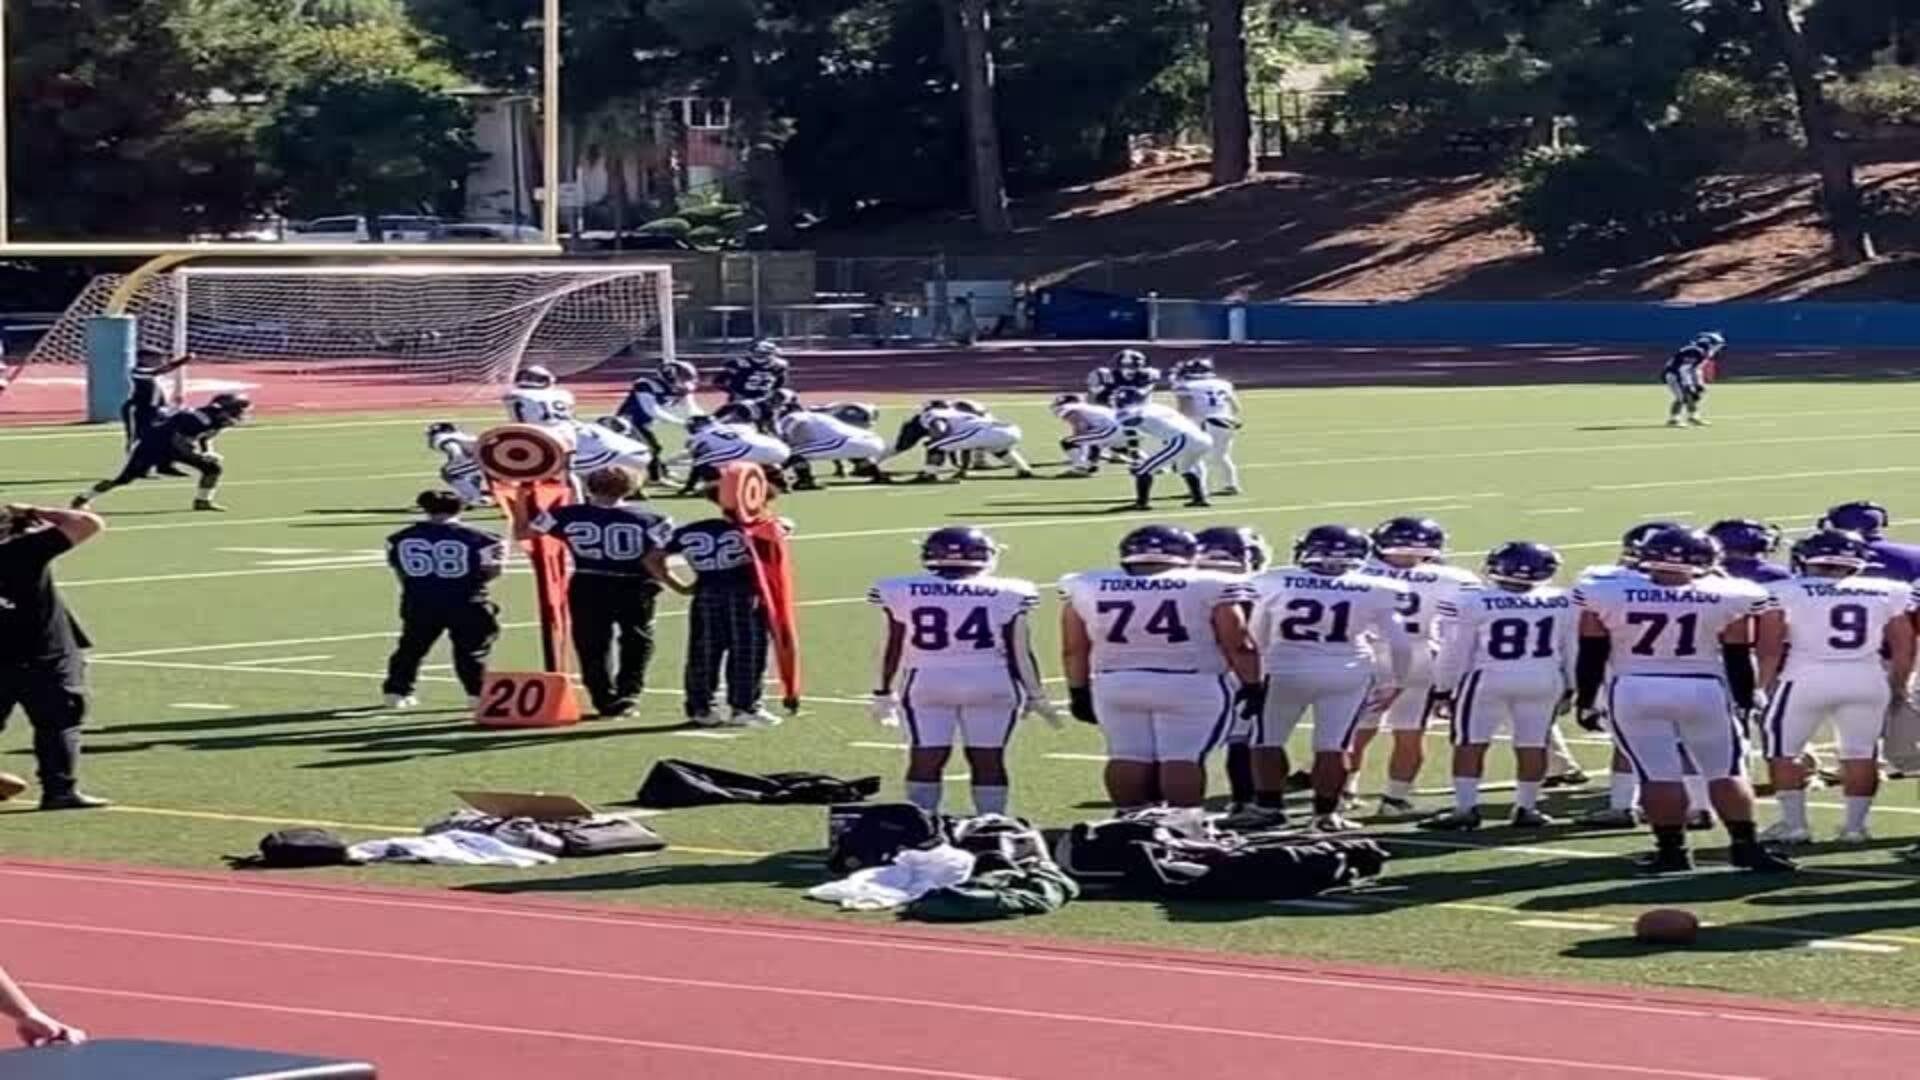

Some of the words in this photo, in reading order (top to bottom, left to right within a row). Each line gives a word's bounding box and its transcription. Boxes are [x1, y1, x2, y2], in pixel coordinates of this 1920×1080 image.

[398, 538, 469, 578] 68
[564, 521, 643, 560] 20
[679, 531, 752, 571] 22
[909, 583, 998, 596] TORNADO
[1100, 578, 1188, 591] TORNADO
[911, 605, 995, 651] 84
[1097, 599, 1190, 643] 74
[1280, 598, 1351, 642] 21
[1488, 616, 1554, 661] 81
[1626, 612, 1698, 656] 71
[1828, 603, 1867, 650] 9
[483, 679, 545, 718] 20
